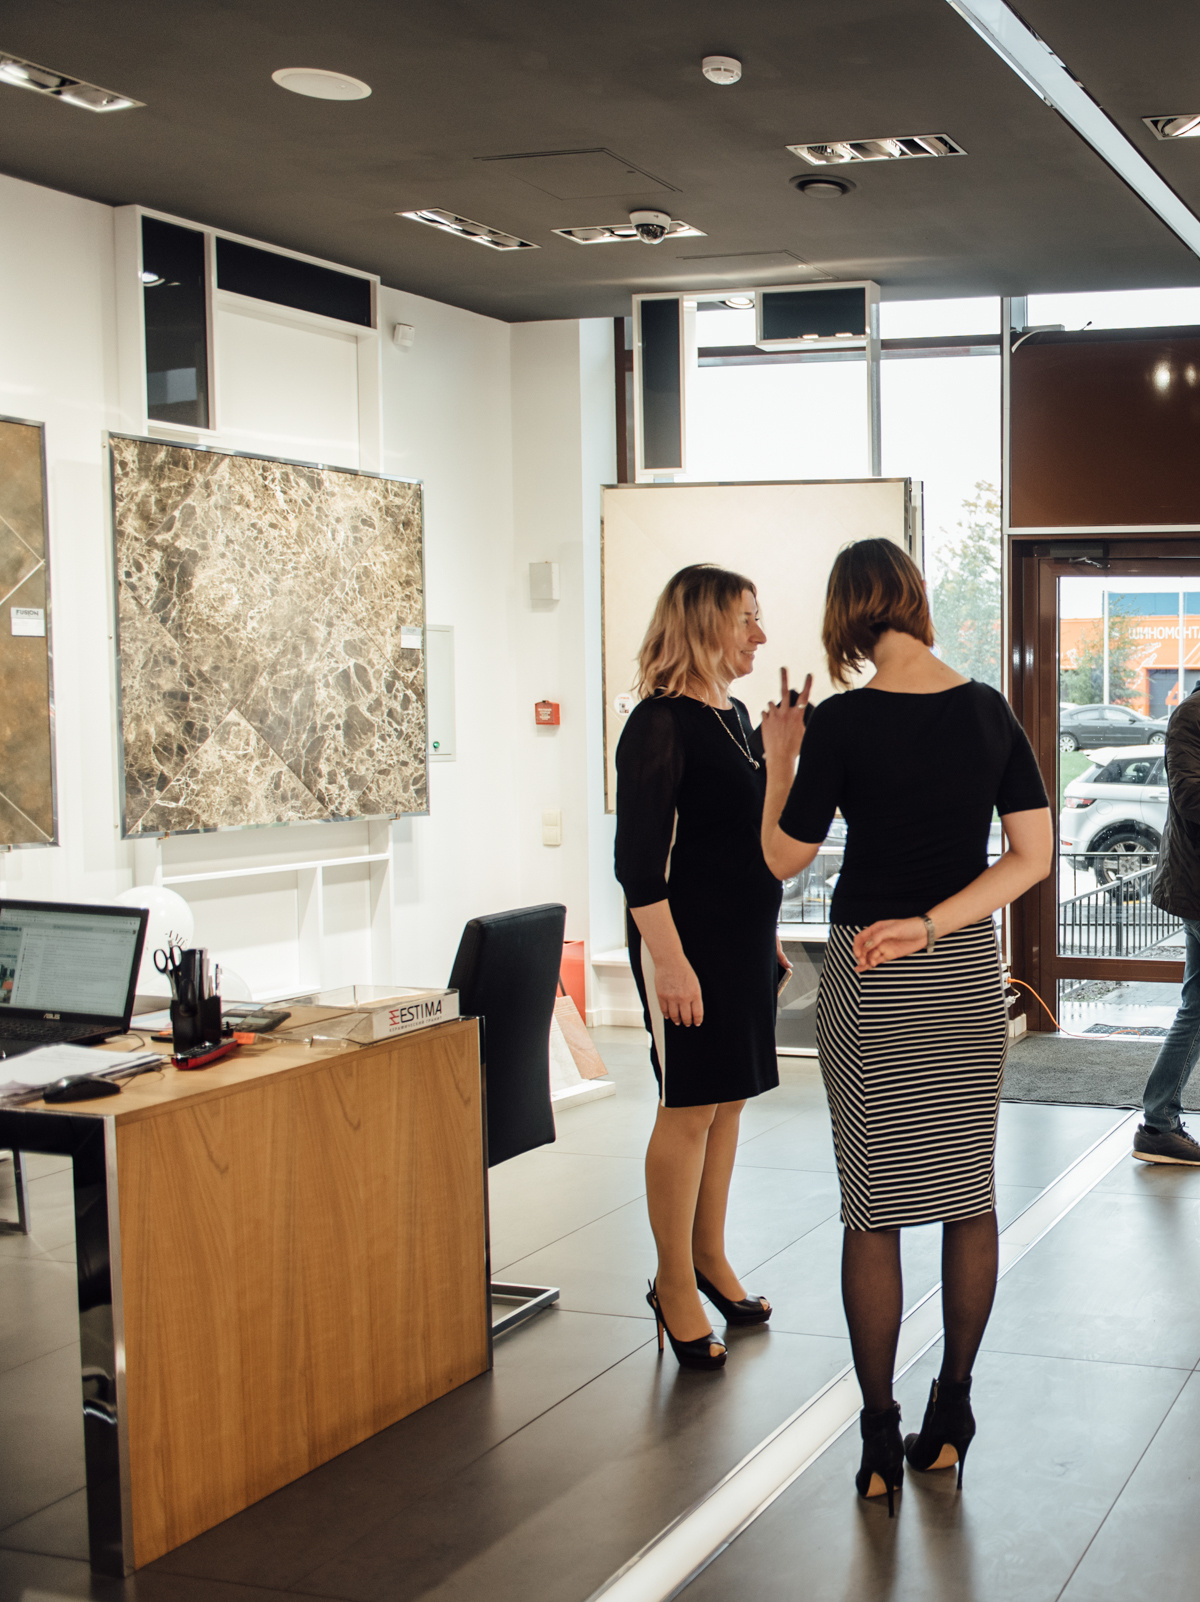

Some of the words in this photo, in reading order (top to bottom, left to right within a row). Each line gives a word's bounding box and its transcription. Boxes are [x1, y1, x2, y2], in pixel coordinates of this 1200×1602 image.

[400, 1000, 442, 1023] ESTIMA
[43, 1012, 61, 1020] ASUS
[426, 1016, 443, 1024] ГРАНИТ
